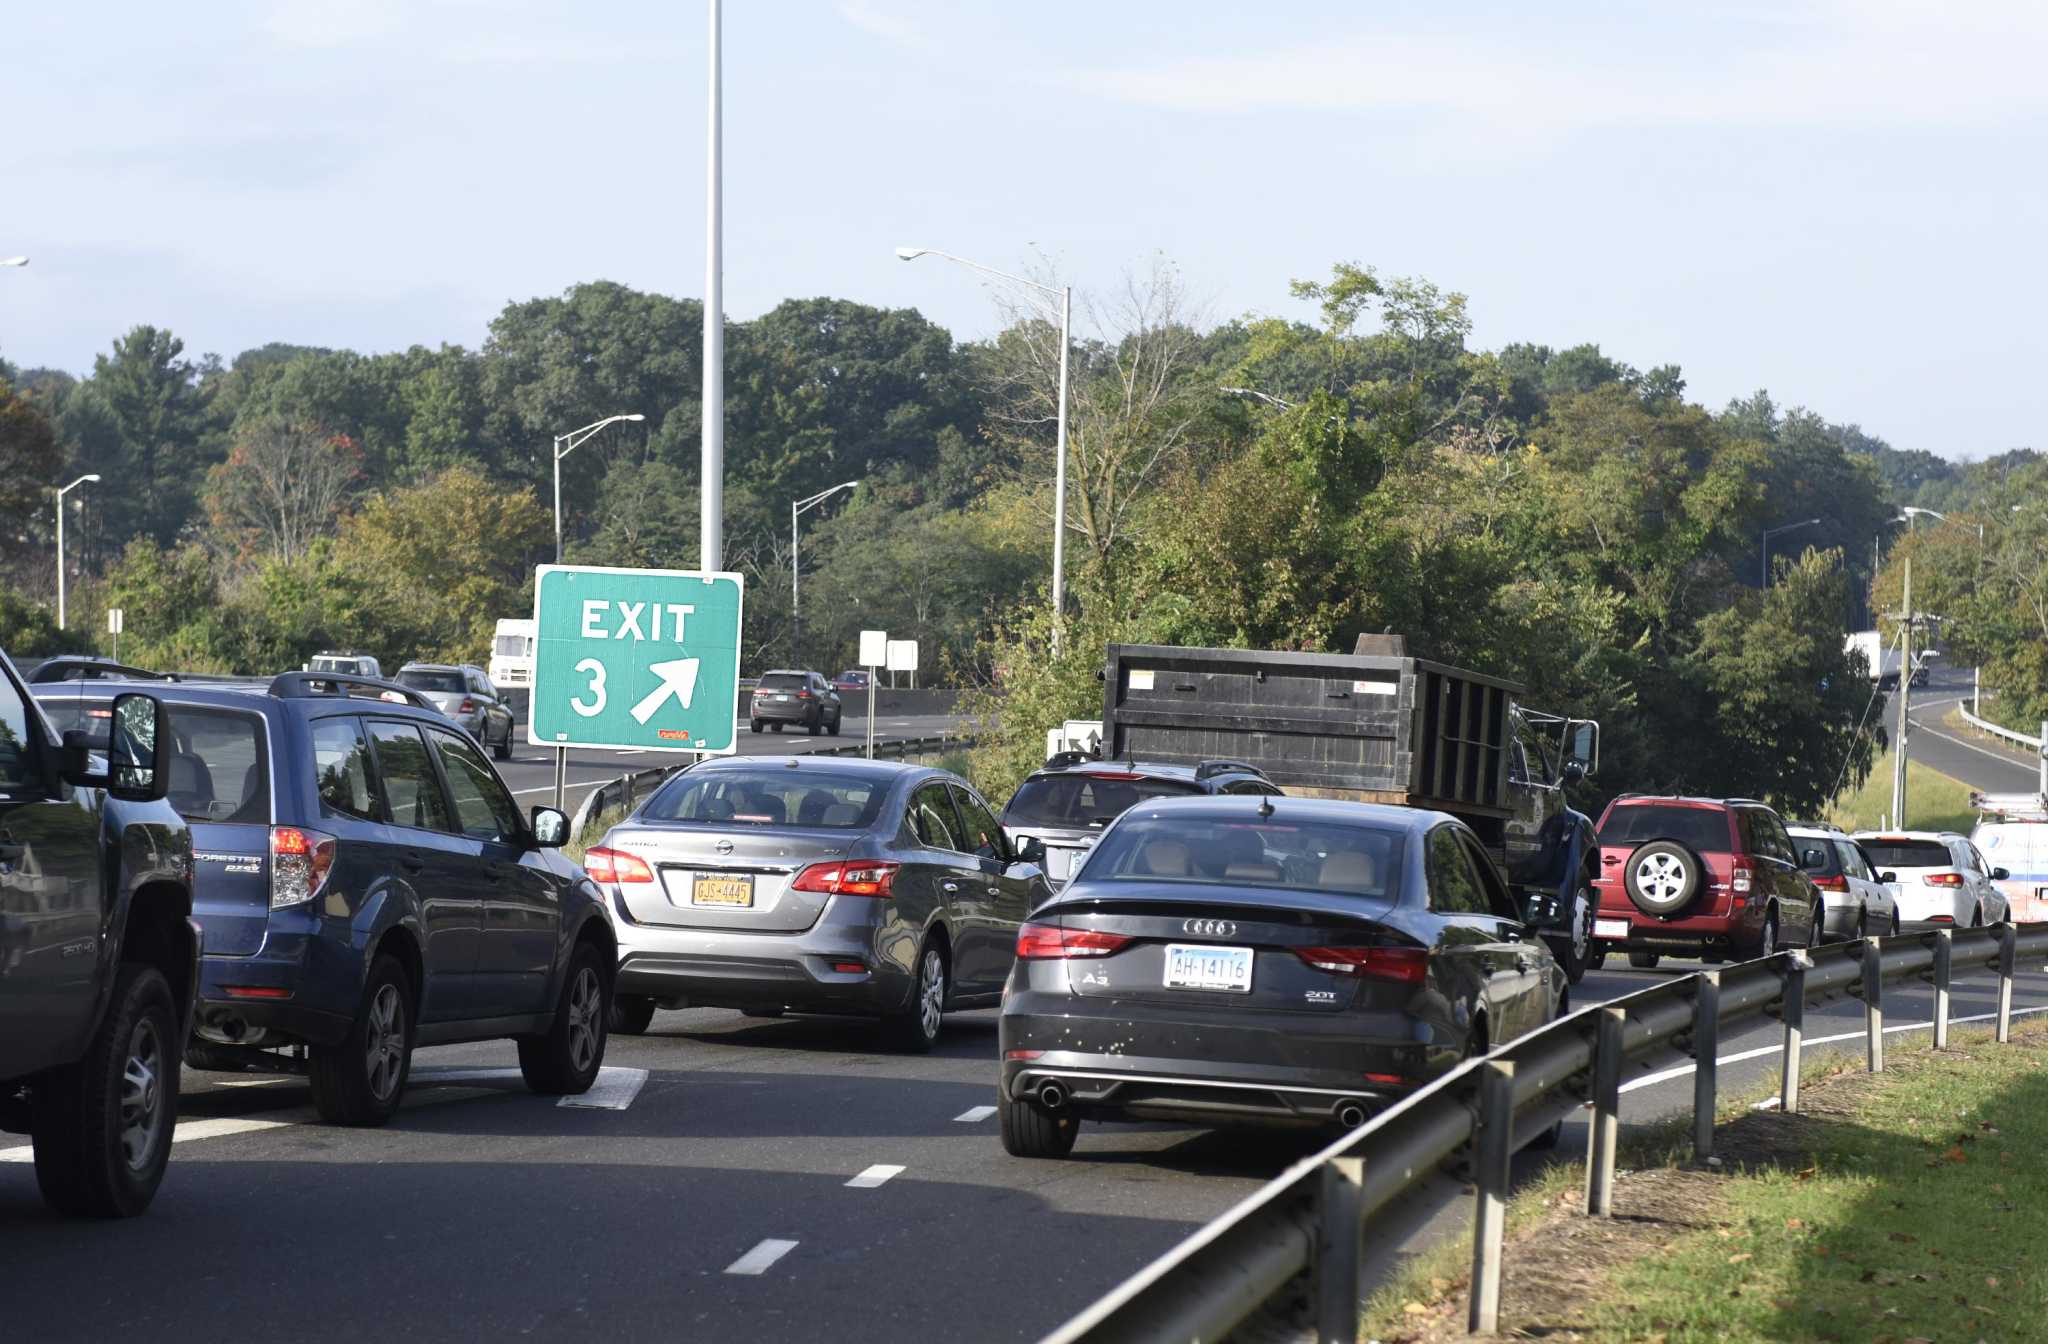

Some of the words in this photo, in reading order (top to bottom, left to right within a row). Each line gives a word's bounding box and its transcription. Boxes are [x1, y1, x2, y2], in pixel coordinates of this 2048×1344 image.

[581, 599, 695, 643] EXIT
[570, 657, 608, 717] 3
[1082, 972, 1108, 985] A3
